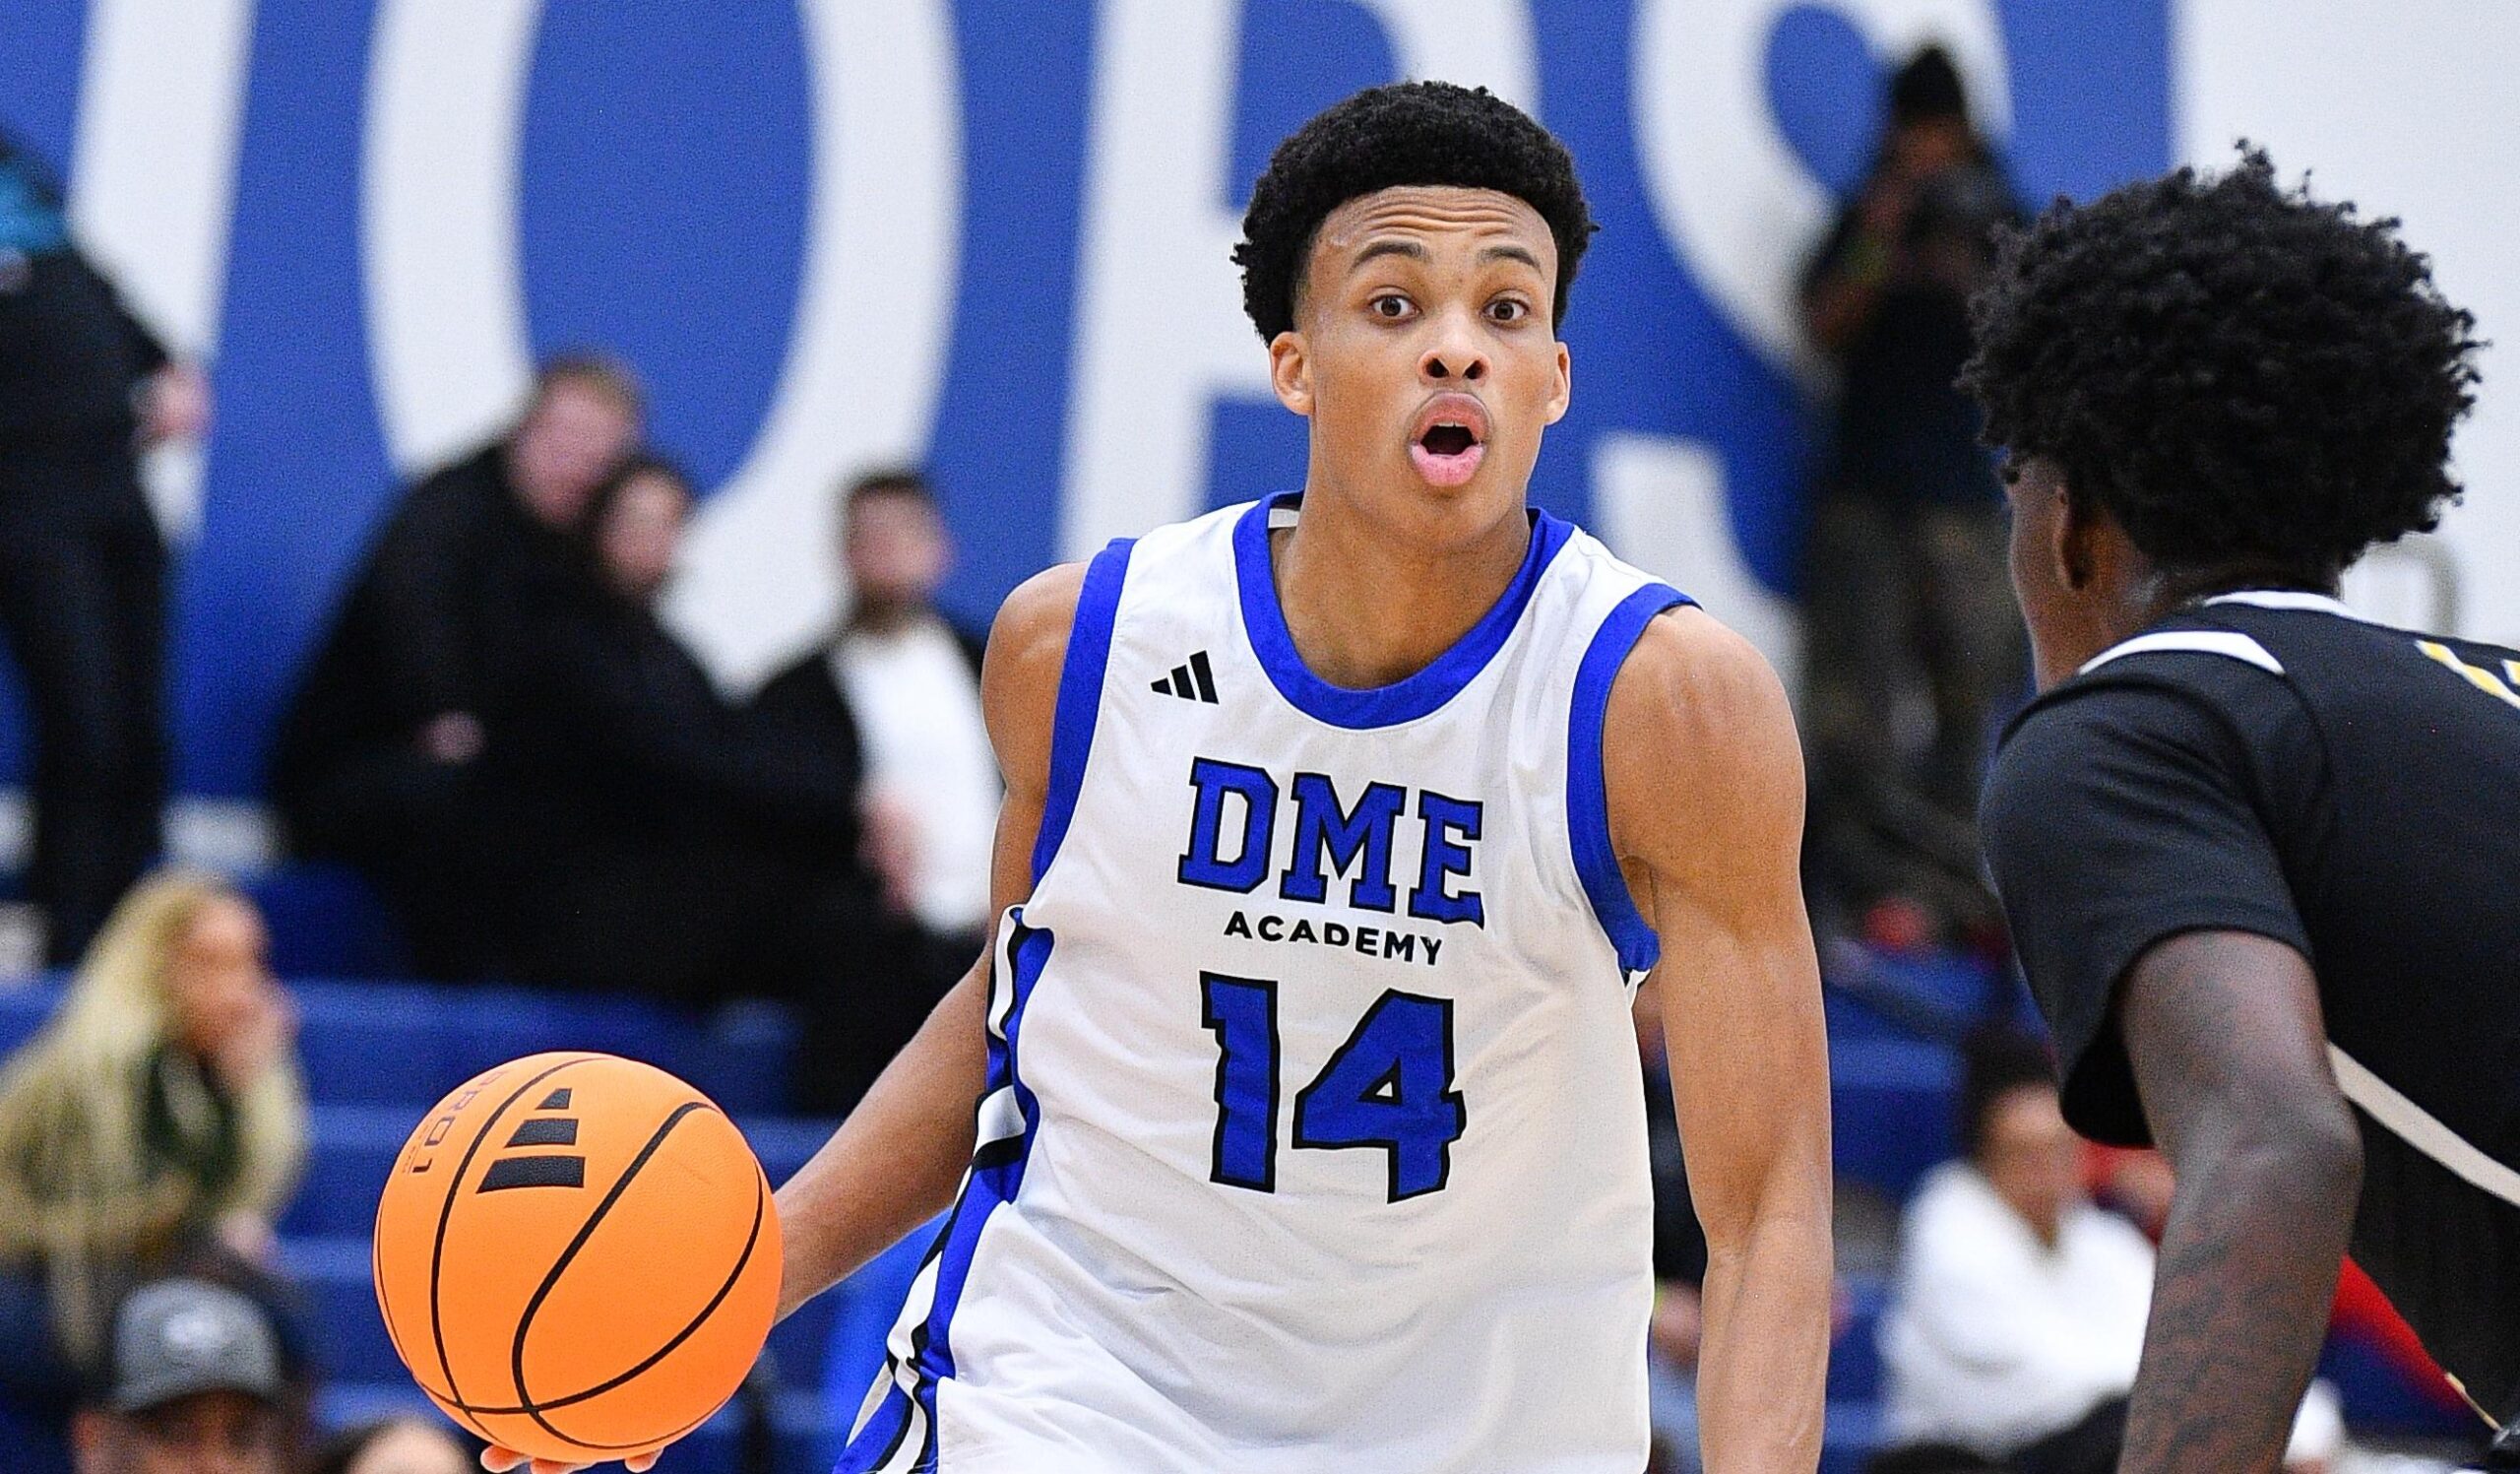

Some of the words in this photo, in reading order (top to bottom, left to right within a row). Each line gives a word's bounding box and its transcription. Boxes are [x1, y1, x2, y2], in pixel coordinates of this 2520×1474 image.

[1177, 755, 1485, 929] DME
[1224, 911, 1443, 966] ACADEMY
[1199, 970, 1468, 1204] 14
